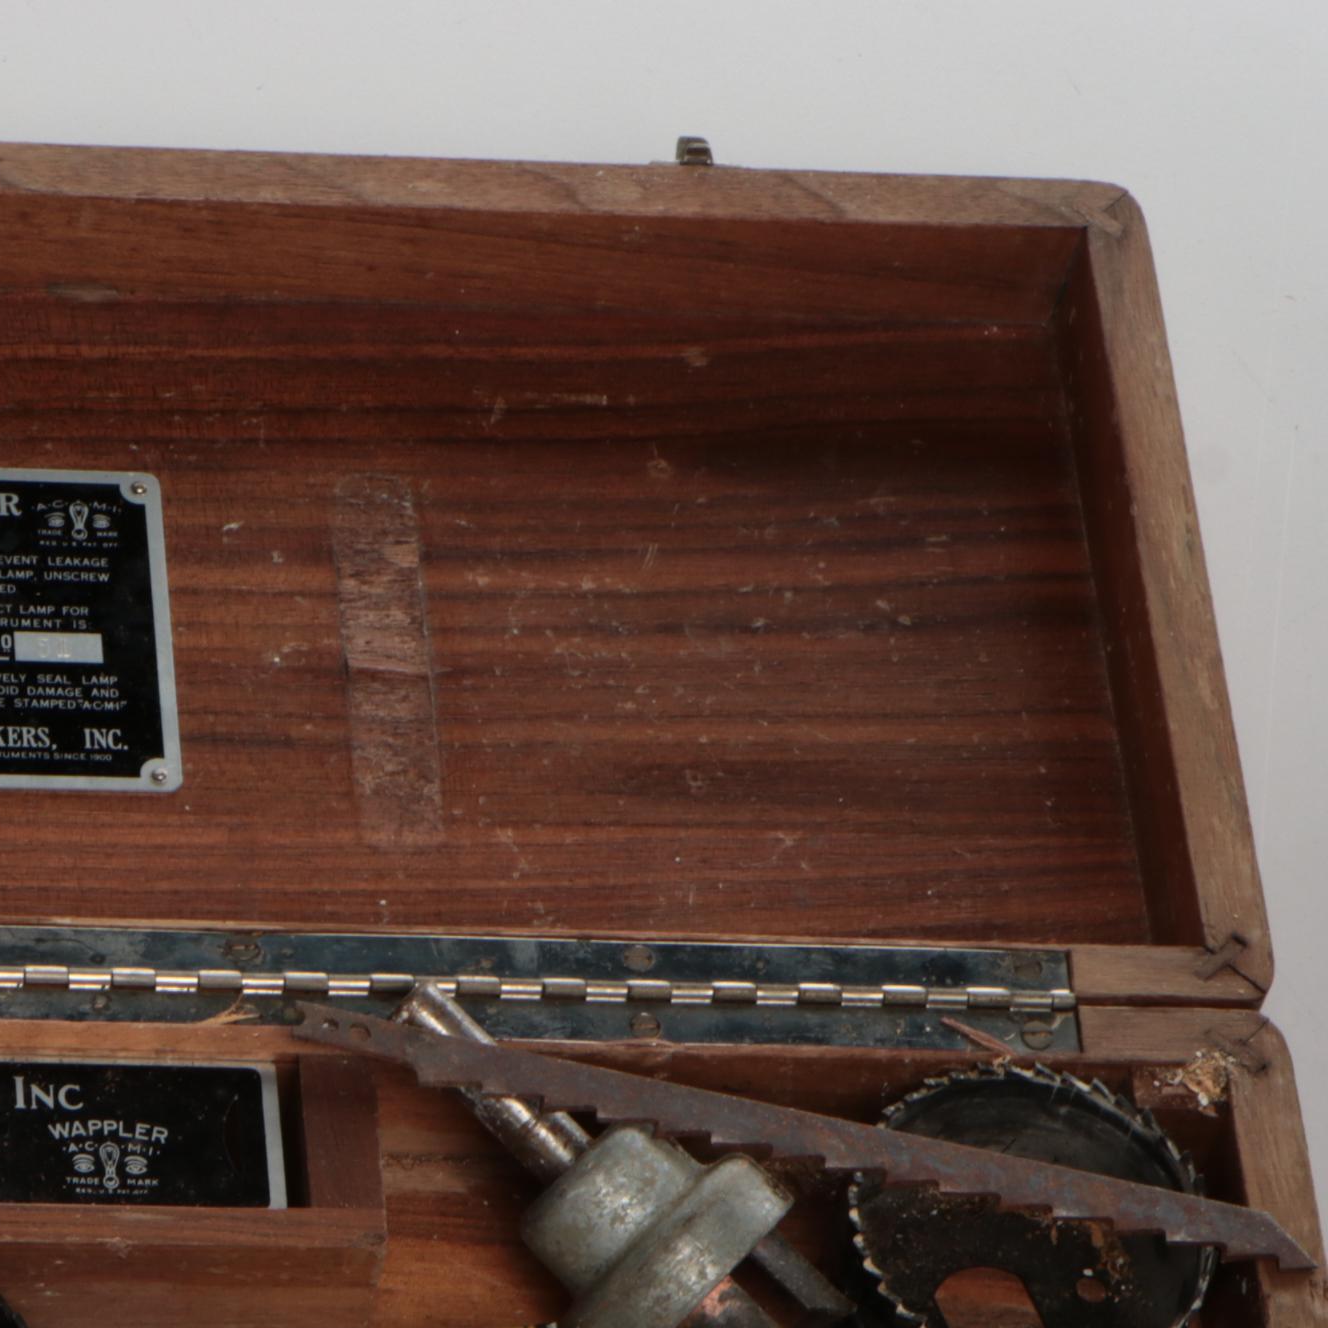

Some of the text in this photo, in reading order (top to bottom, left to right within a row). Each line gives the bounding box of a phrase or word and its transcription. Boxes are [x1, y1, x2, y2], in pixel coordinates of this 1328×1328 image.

[47, 557, 107, 567] LEAKAGE
[44, 571, 109, 581] UNSCREW
[19, 605, 54, 614] LAMP
[62, 606, 88, 615] FOR
[37, 674, 70, 684] SEAL
[82, 675, 117, 684] LAMP
[27, 686, 81, 696] DAMAGE
[91, 688, 118, 697] AND
[83, 728, 128, 749] INC.
[47, 1119, 169, 1146] WAPPLER
[65, 1176, 161, 1188] TRADE MARK
